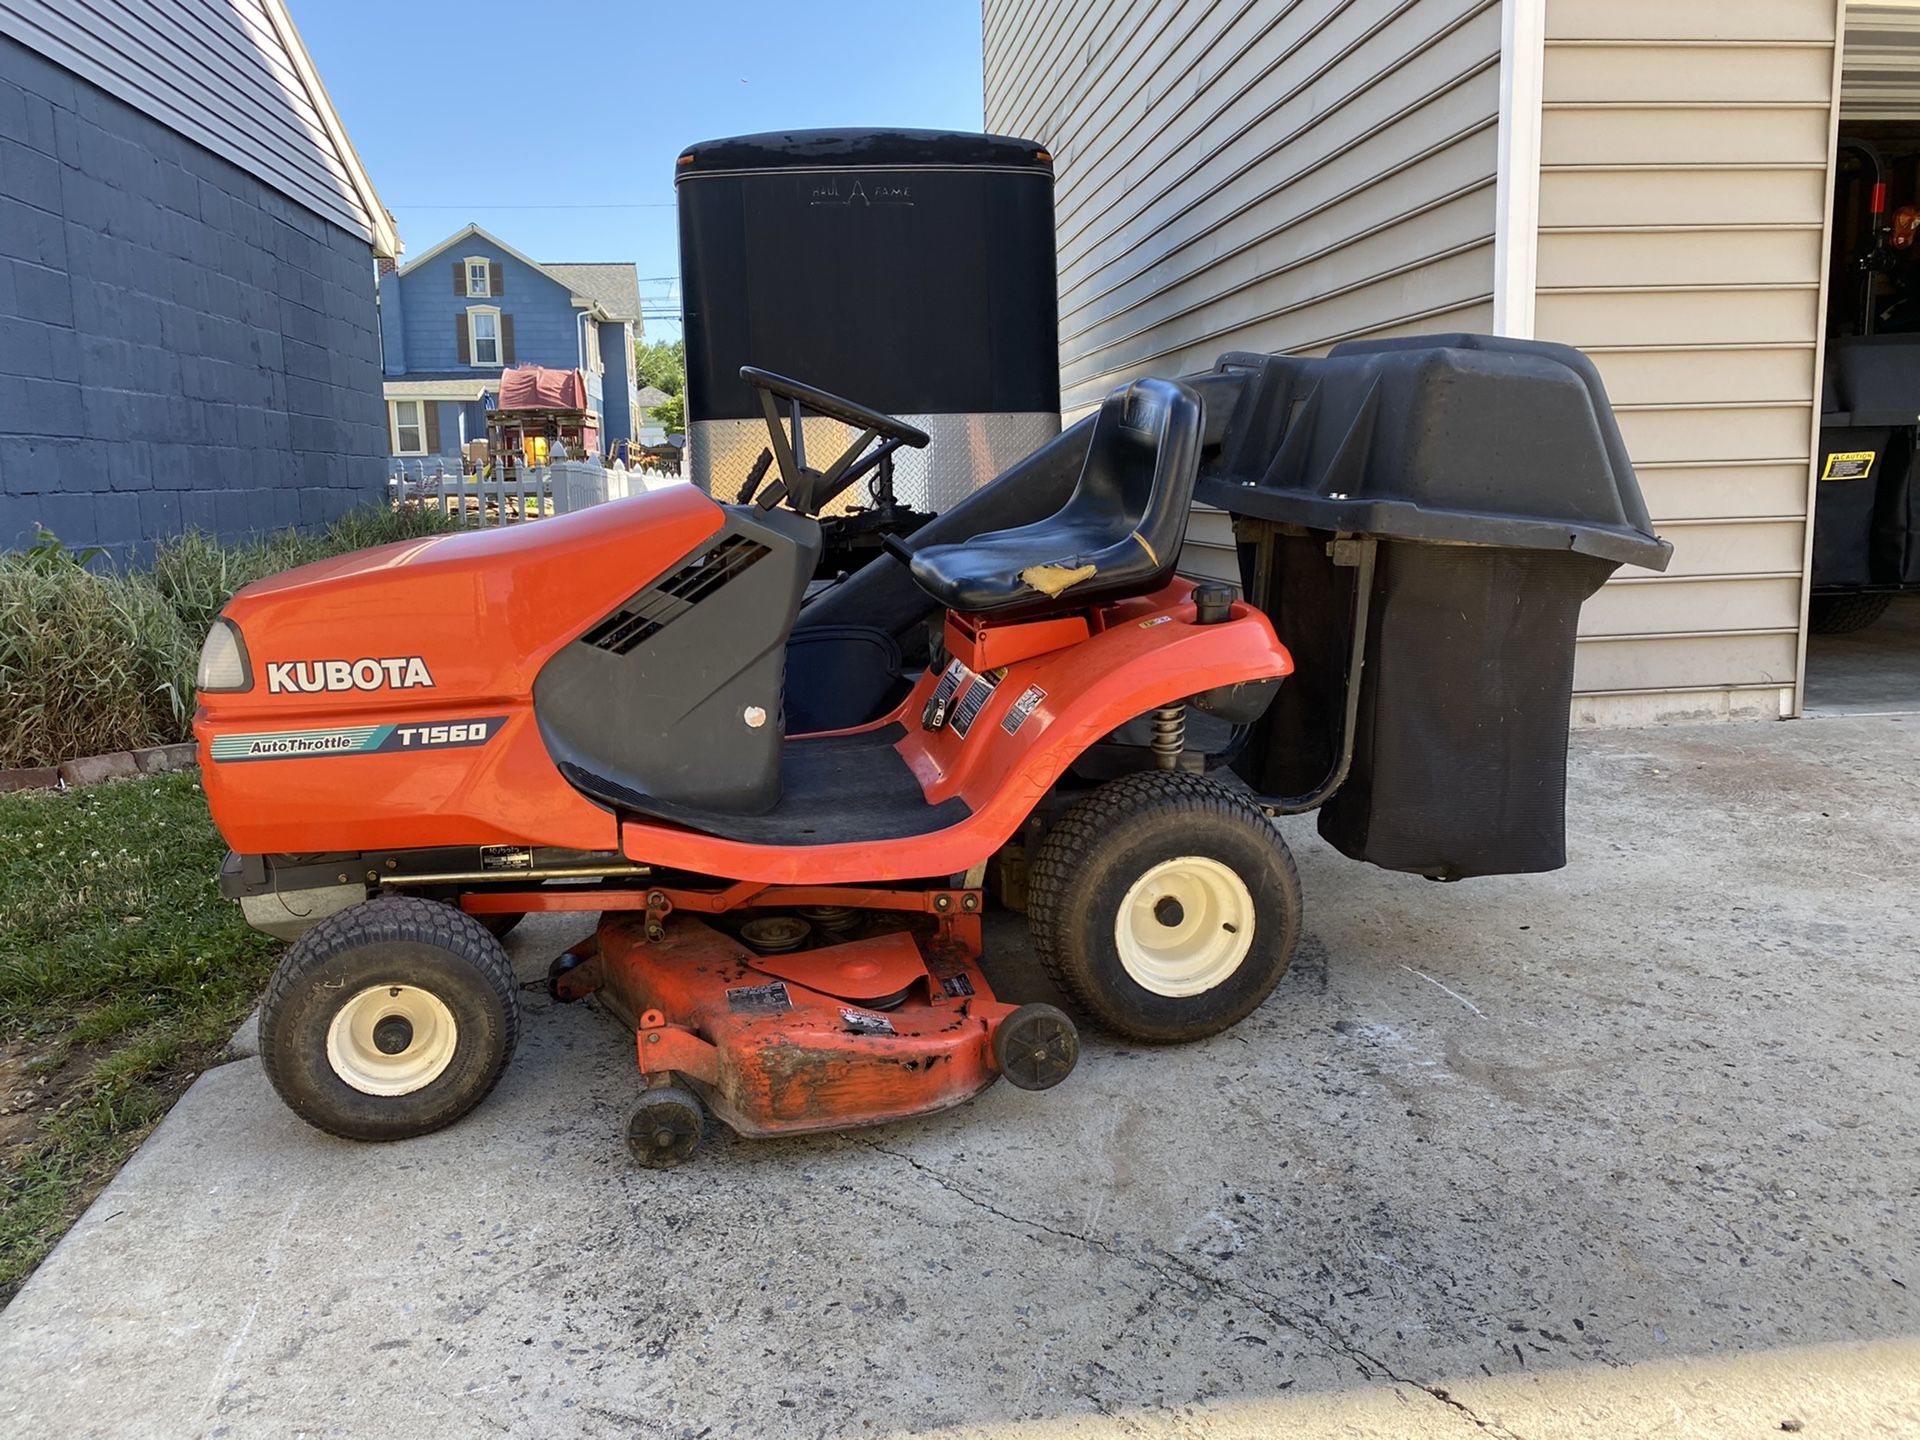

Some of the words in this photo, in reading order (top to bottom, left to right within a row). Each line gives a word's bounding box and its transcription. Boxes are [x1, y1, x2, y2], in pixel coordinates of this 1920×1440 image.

[267, 656, 436, 693] KUBOTA
[249, 736, 351, 755] AutoThrottle
[397, 723, 487, 746] T1560
